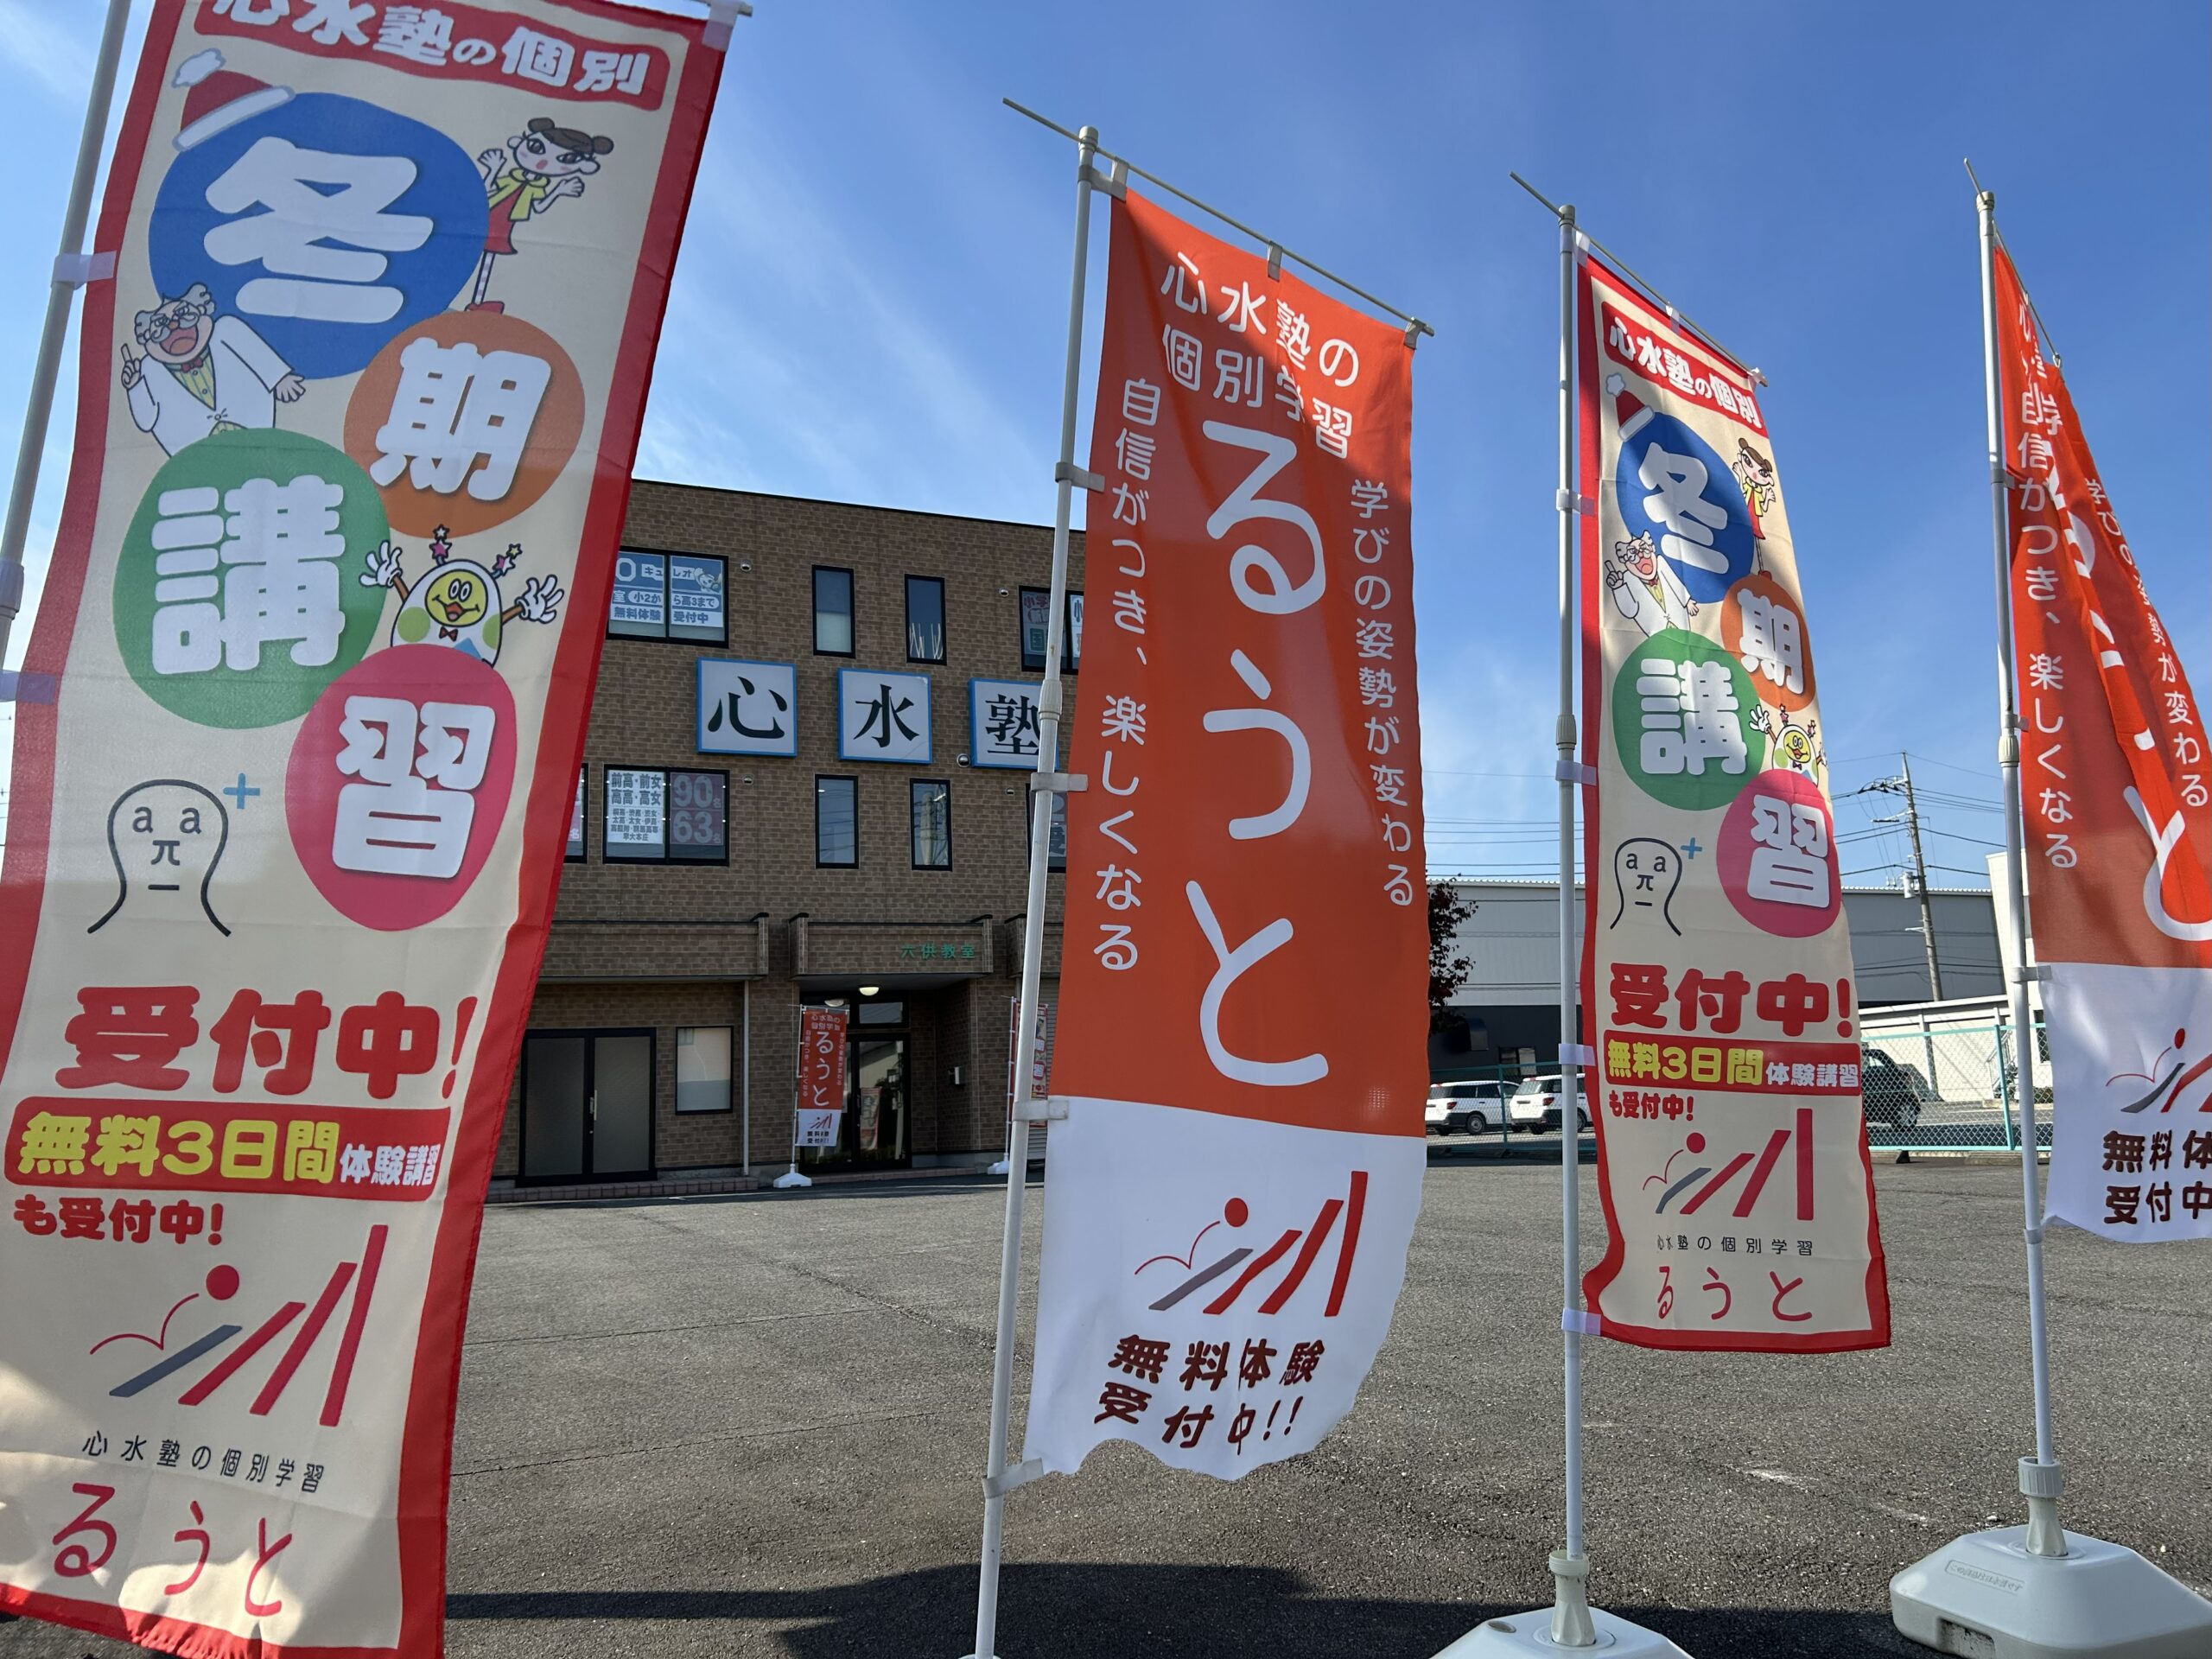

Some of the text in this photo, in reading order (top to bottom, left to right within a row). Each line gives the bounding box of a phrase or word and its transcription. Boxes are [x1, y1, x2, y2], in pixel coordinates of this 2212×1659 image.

[1161, 251, 1359, 387] 心水塾の
[1609, 315, 1764, 429] 心水塾の個別
[1351, 479, 1413, 906] 学びの姿勢が変わる
[1185, 419, 1329, 1086] るうと
[900, 943, 976, 960] 六供教室
[1610, 962, 1853, 1038] 受付中!
[55, 986, 479, 1099] 受付中!
[812, 1031, 834, 1107] るうと
[1609, 1090, 1694, 1121] も受付中!
[14, 1193, 224, 1245] も受付中!
[1657, 1266, 1813, 1322] るうと
[1108, 1334, 1325, 1391] 無料体験
[83, 1430, 326, 1492] 心水塾の個別学習
[52, 1483, 293, 1616] るうと
